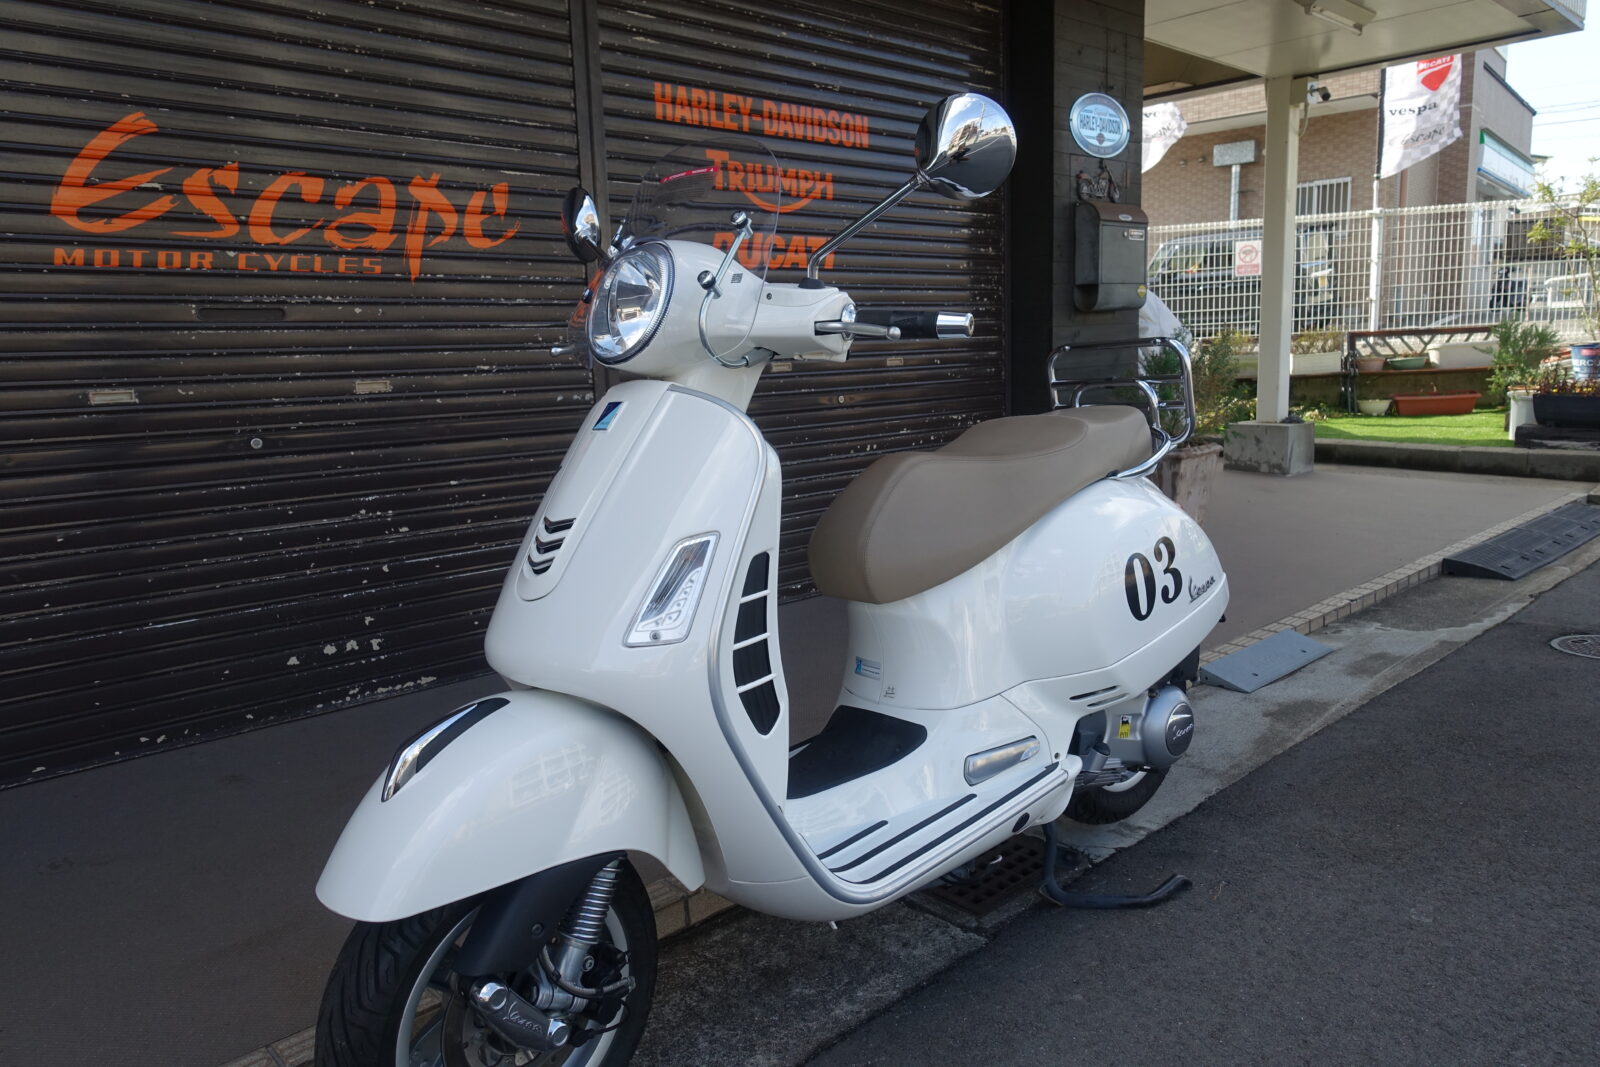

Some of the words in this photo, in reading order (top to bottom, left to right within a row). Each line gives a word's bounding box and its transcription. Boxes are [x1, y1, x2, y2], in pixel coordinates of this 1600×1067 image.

[653, 81, 869, 148] HARLEY-DAVIDSON
[1389, 101, 1439, 116] vespa
[50, 111, 522, 283] Escape
[705, 148, 834, 213] TRIUMPH
[53, 247, 213, 270] MOTOR
[237, 252, 383, 275] CYCLES
[1125, 536, 1183, 622] 03
